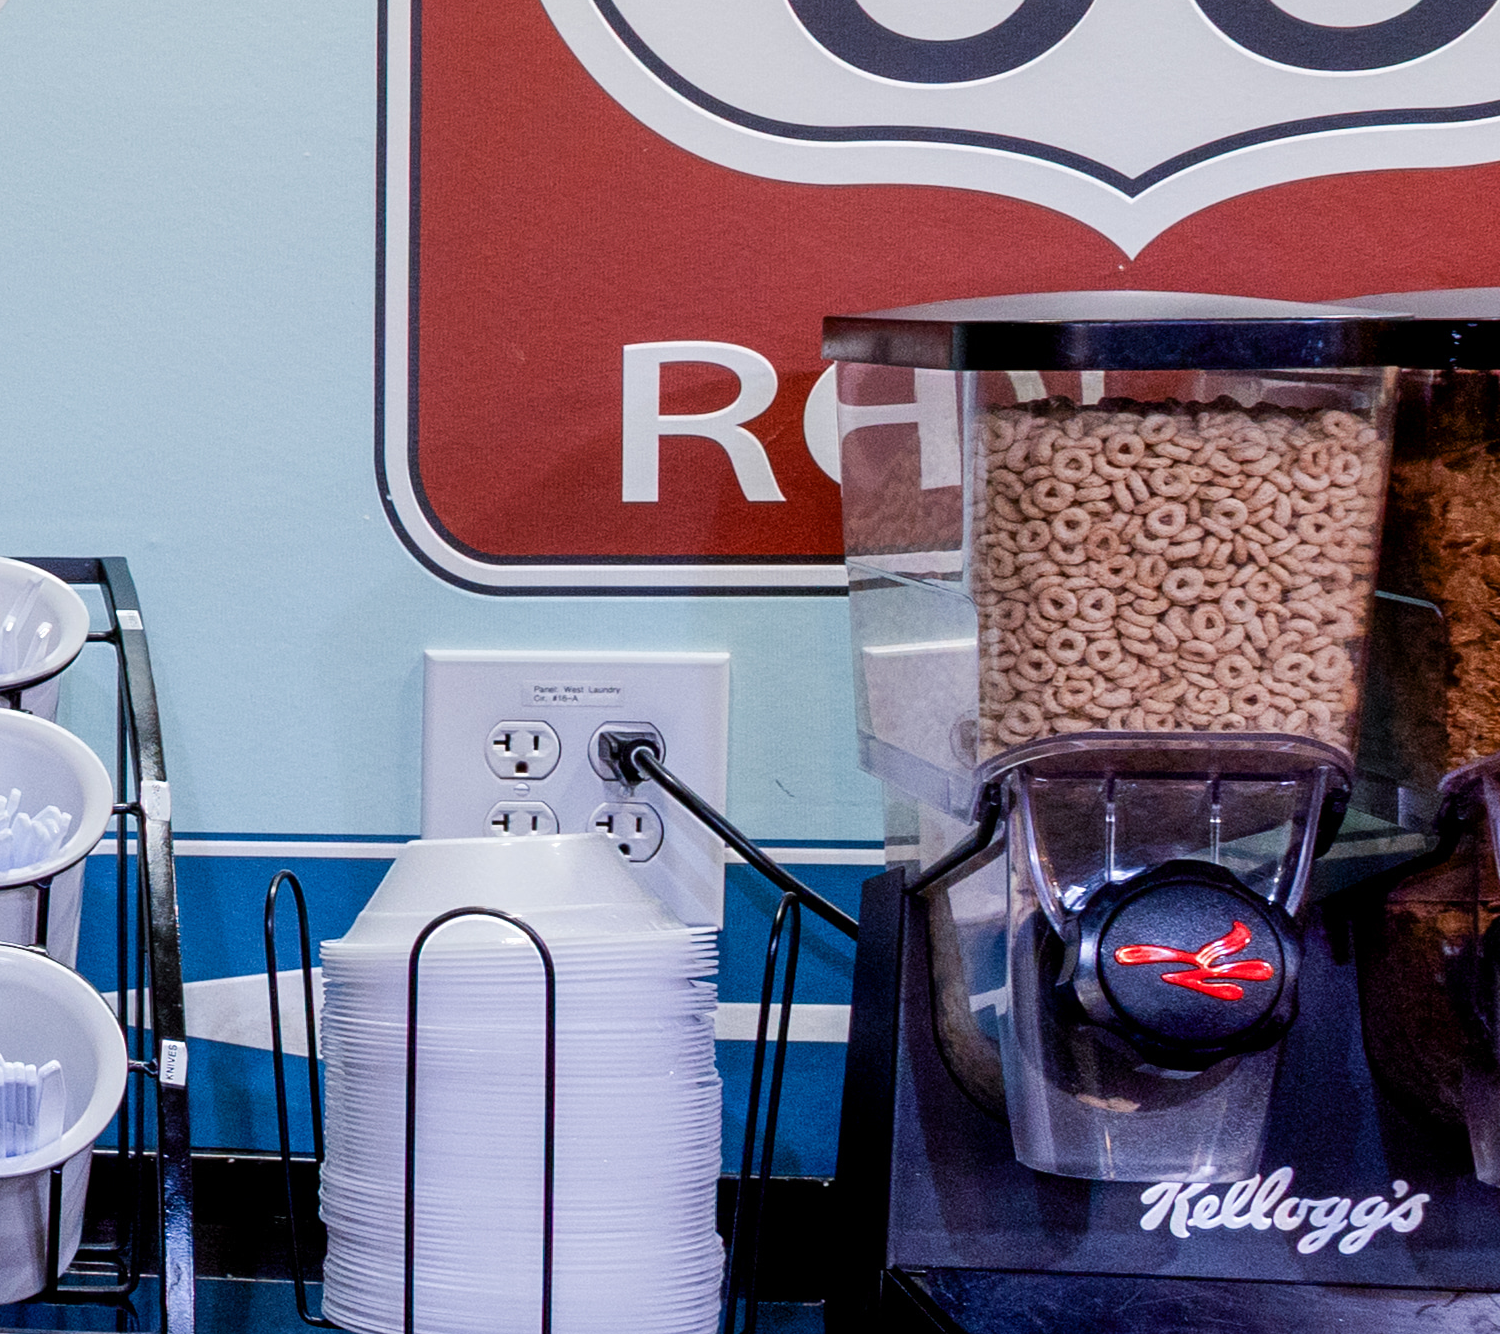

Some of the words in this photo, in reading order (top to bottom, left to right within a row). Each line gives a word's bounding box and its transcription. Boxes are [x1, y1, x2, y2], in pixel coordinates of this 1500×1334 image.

[563, 685, 584, 694] West
[588, 685, 621, 695] Laundry
[164, 1044, 178, 1082] KNIVES
[1139, 1166, 1430, 1256] Kellogg's
